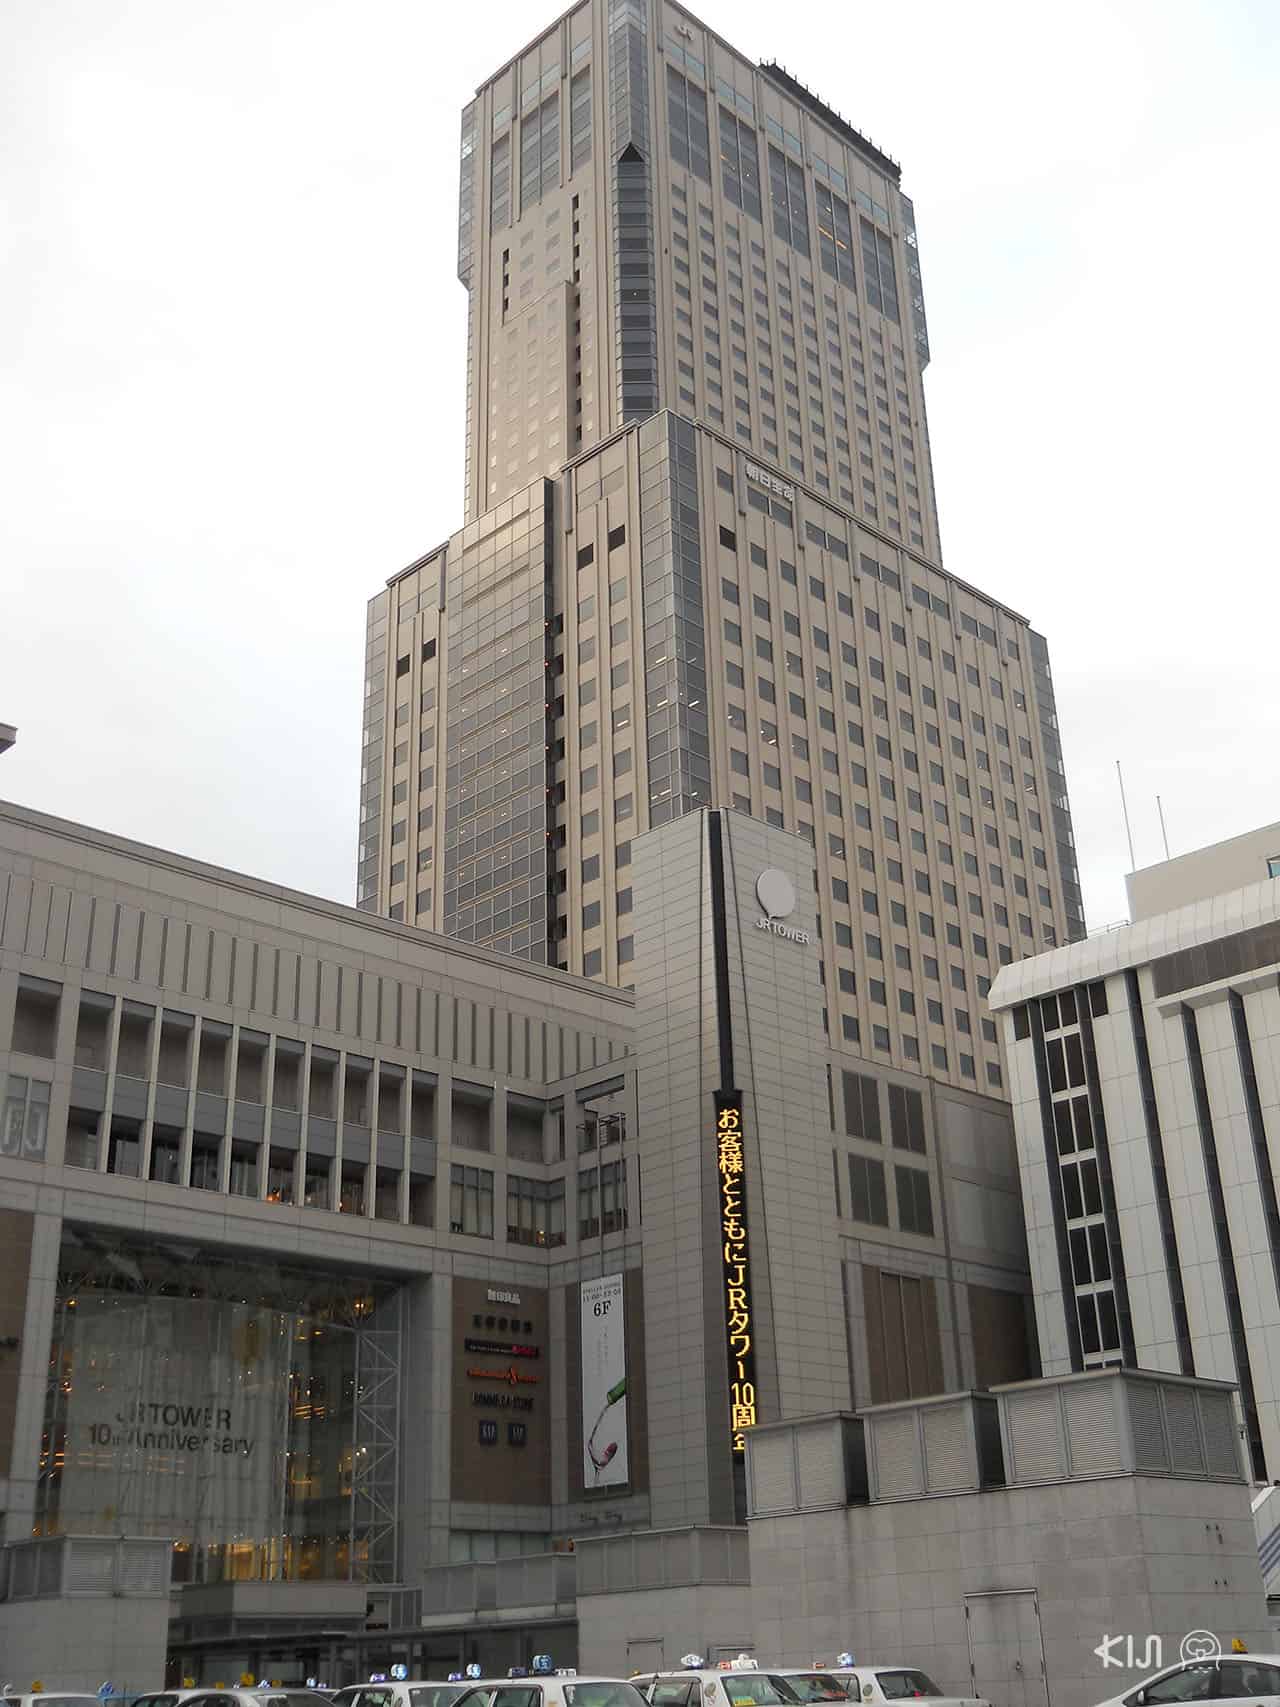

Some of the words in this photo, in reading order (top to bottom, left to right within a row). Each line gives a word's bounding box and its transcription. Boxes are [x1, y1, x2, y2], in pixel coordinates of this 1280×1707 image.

[593, 1300, 611, 1317] 6F
[149, 1403, 232, 1431] TOWER
[127, 1429, 255, 1458] Anniversary
